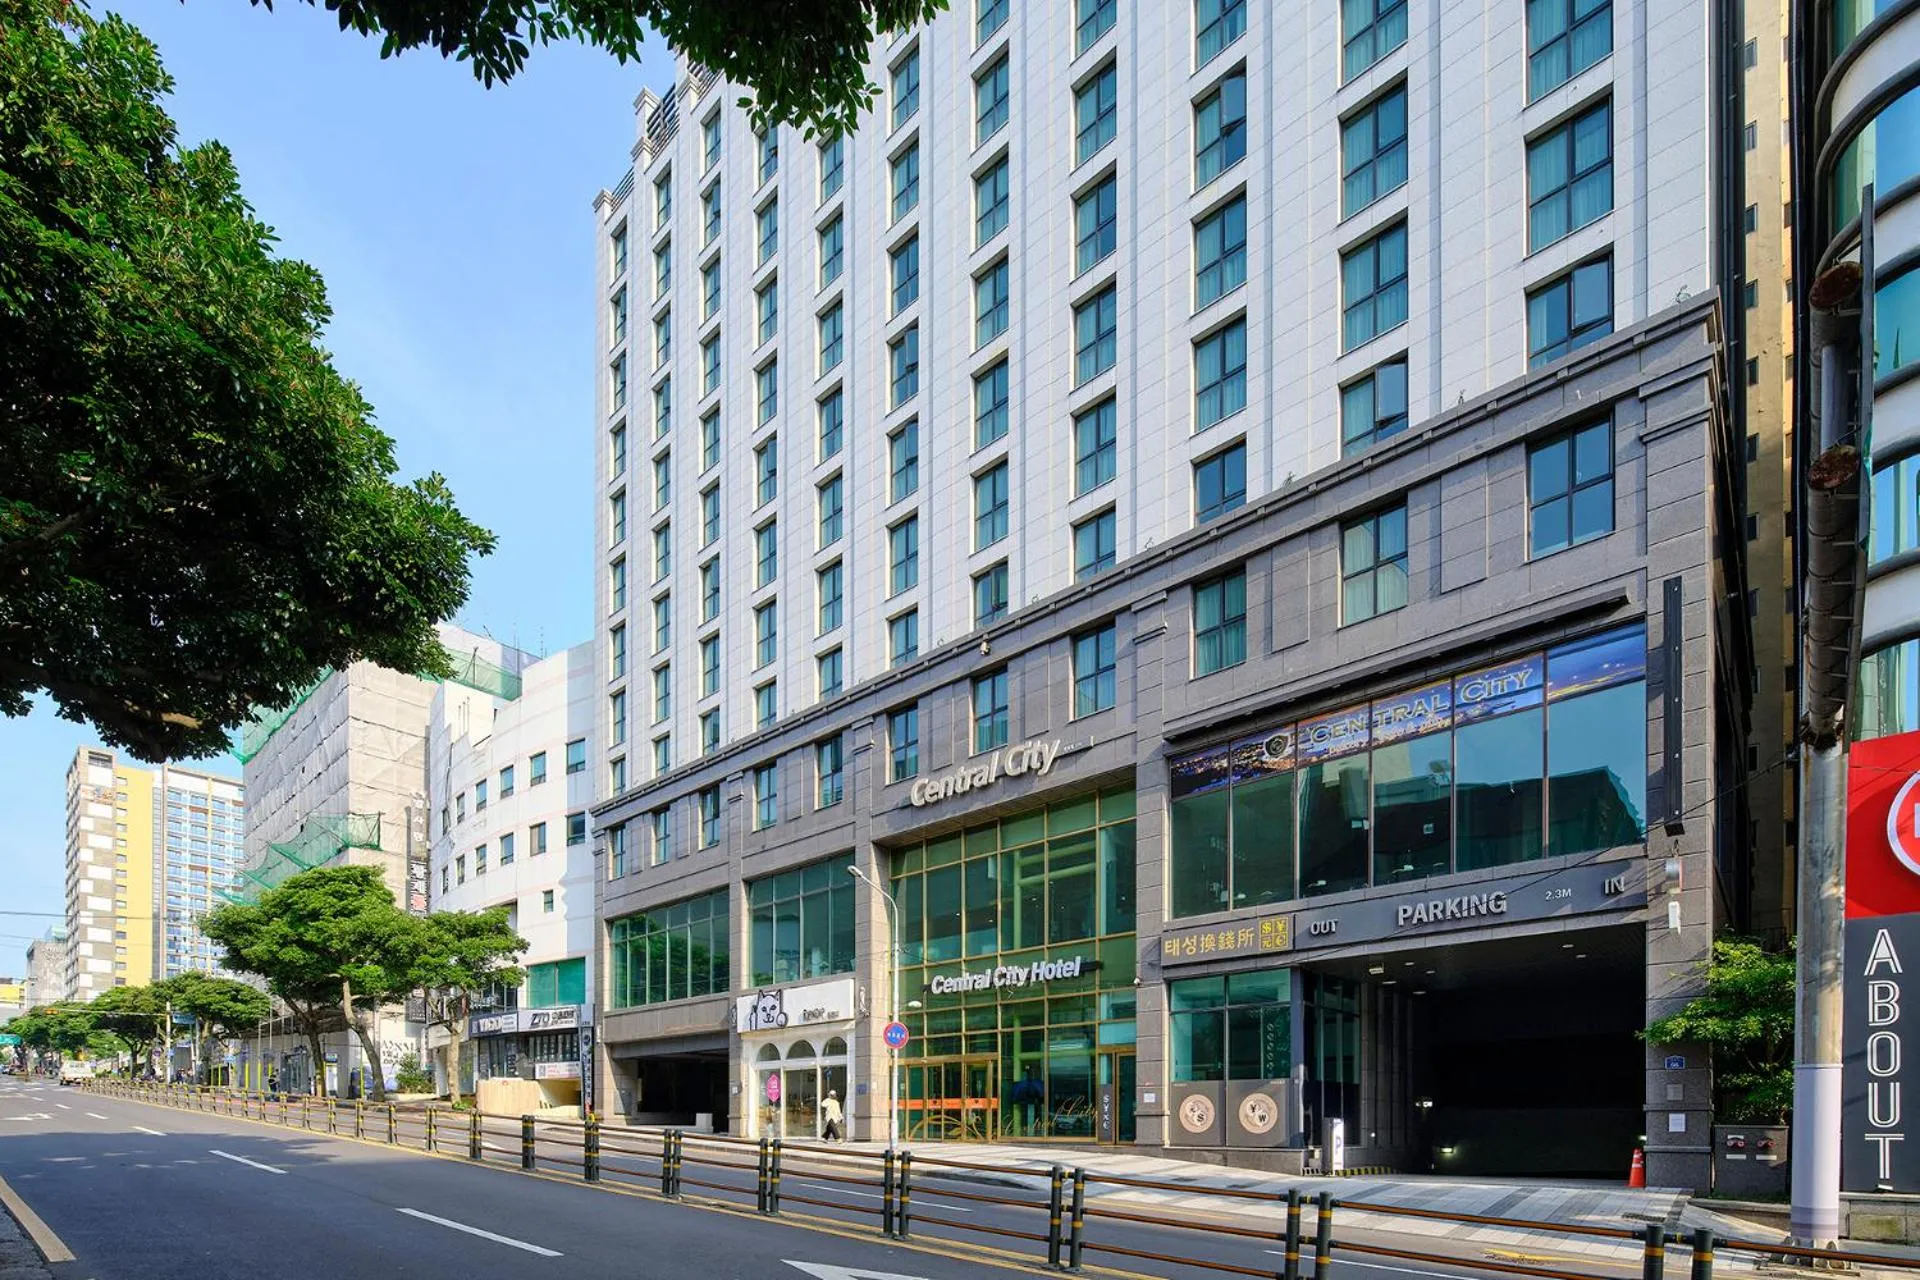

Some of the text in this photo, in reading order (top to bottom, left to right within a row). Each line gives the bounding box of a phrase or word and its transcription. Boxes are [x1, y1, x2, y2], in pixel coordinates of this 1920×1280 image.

[1311, 694, 1450, 743] CENTRAL
[1461, 668, 1533, 703] CITY
[911, 739, 1060, 806] Central City
[1545, 887, 1572, 900] 2.3M
[1604, 876, 1626, 894] IN
[1398, 890, 1507, 925] PARKING
[1310, 919, 1338, 935] OUT
[931, 956, 1081, 994] Central City Hotel
[1864, 928, 1904, 1180] ABOUT
